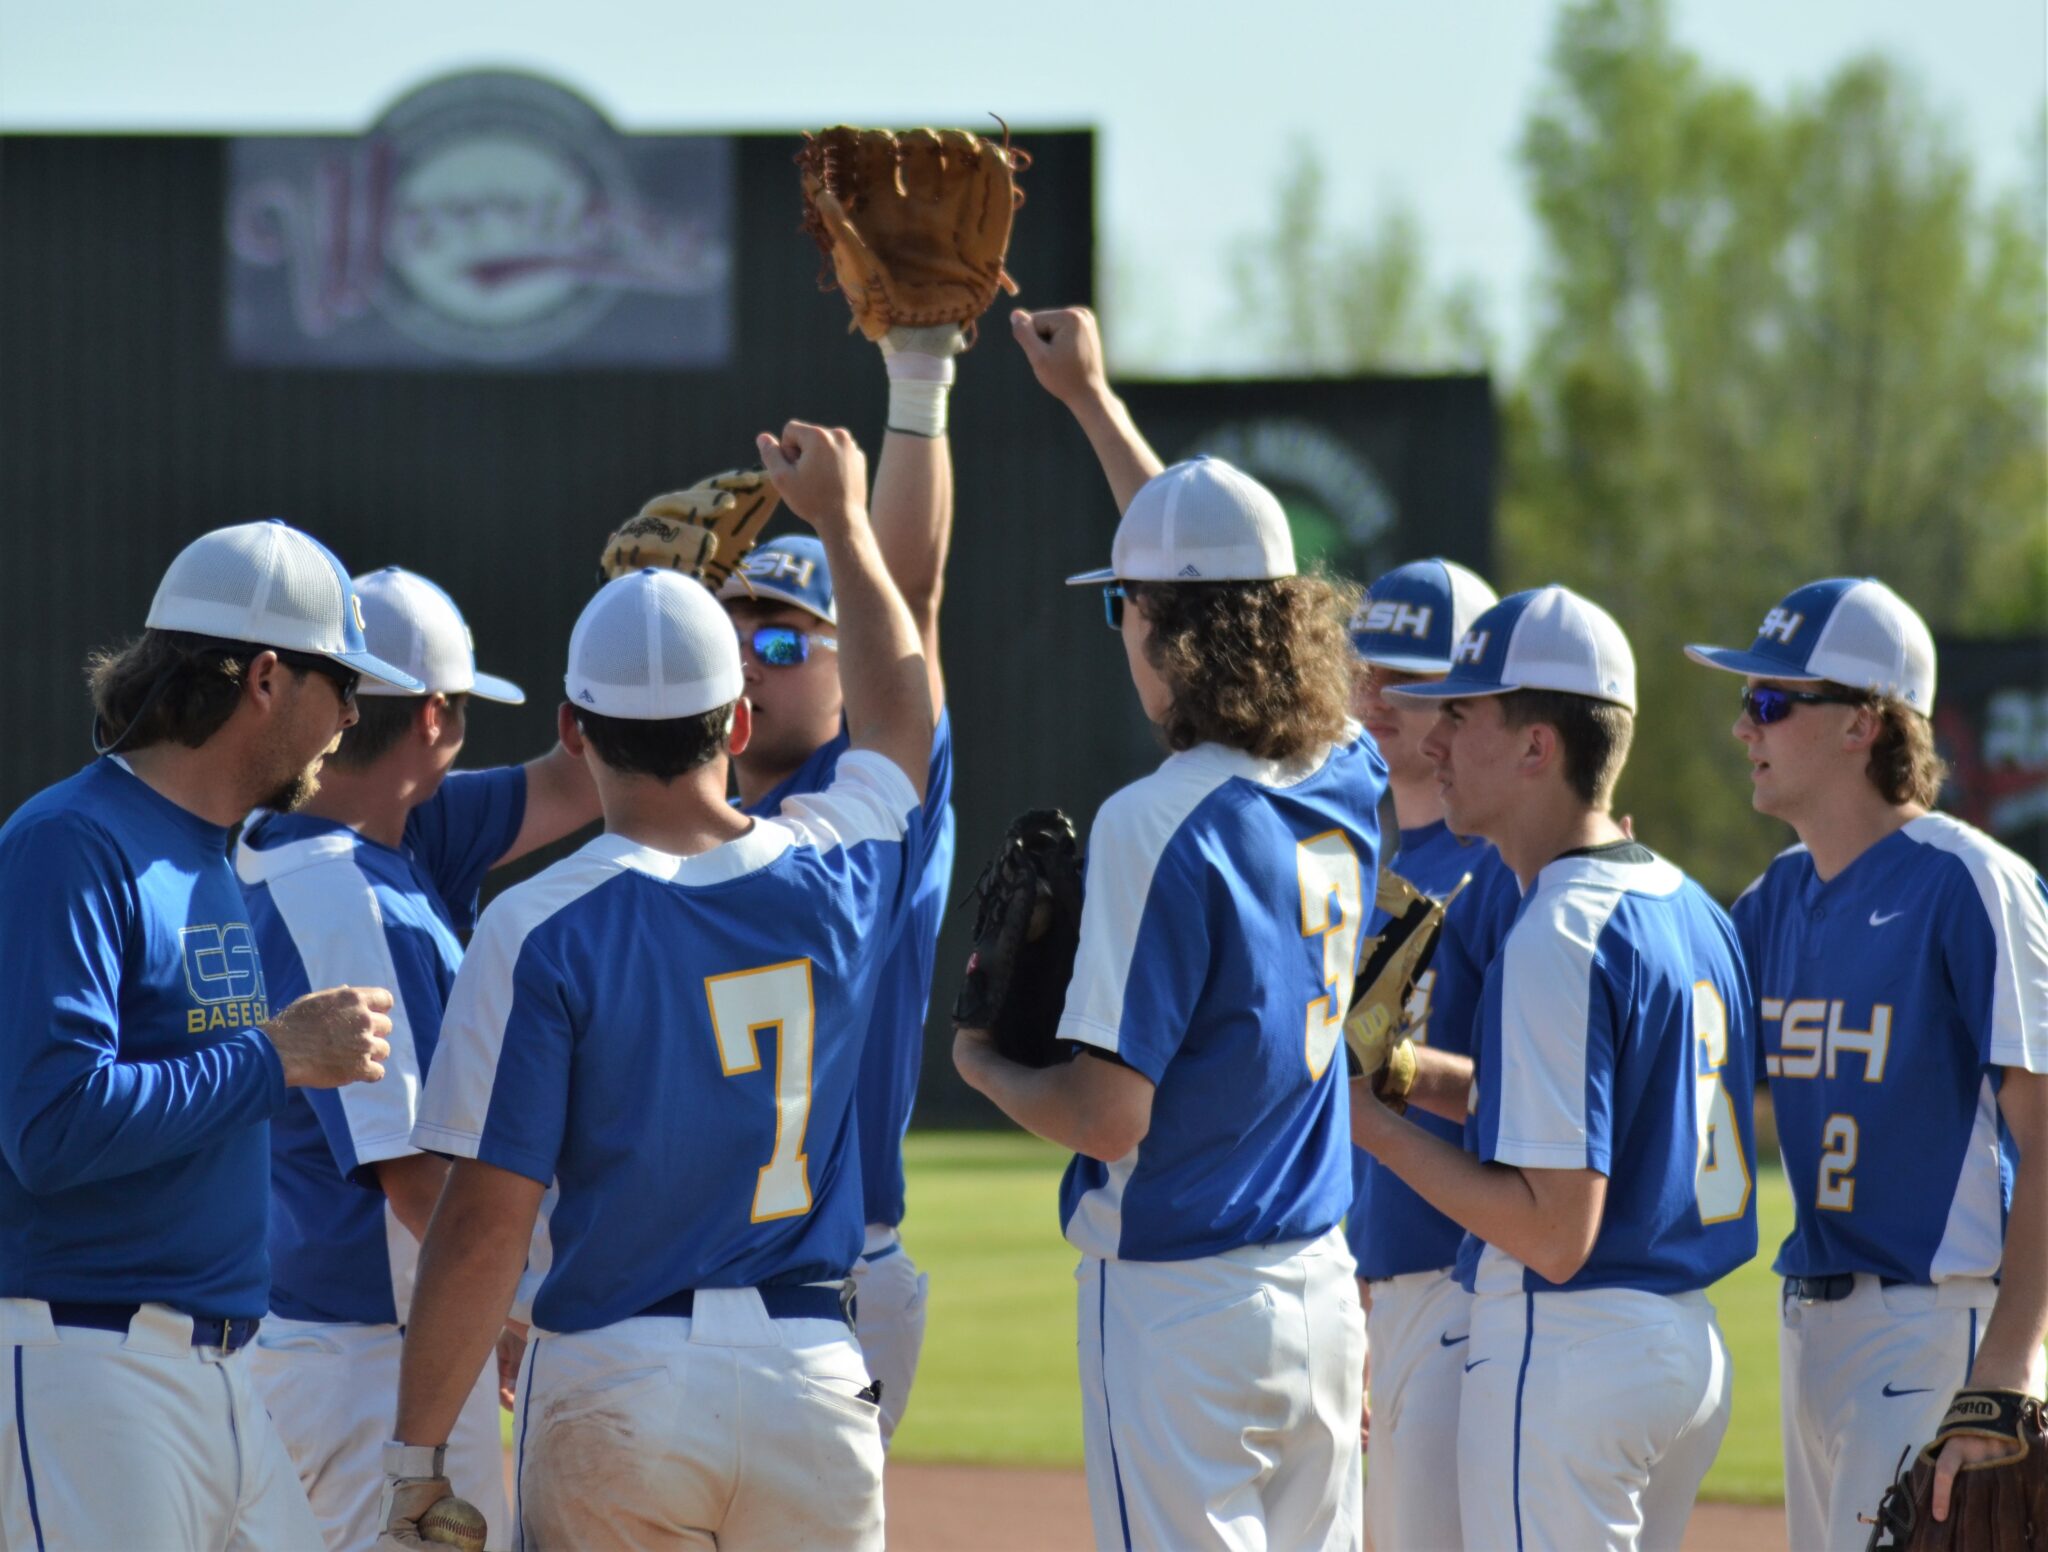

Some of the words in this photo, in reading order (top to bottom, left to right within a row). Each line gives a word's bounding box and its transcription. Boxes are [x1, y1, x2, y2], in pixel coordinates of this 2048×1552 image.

[1296, 828, 1362, 1082] 3
[704, 956, 816, 1224] 7
[1693, 979, 1752, 1226] 6
[1815, 1113, 1859, 1213] 2
